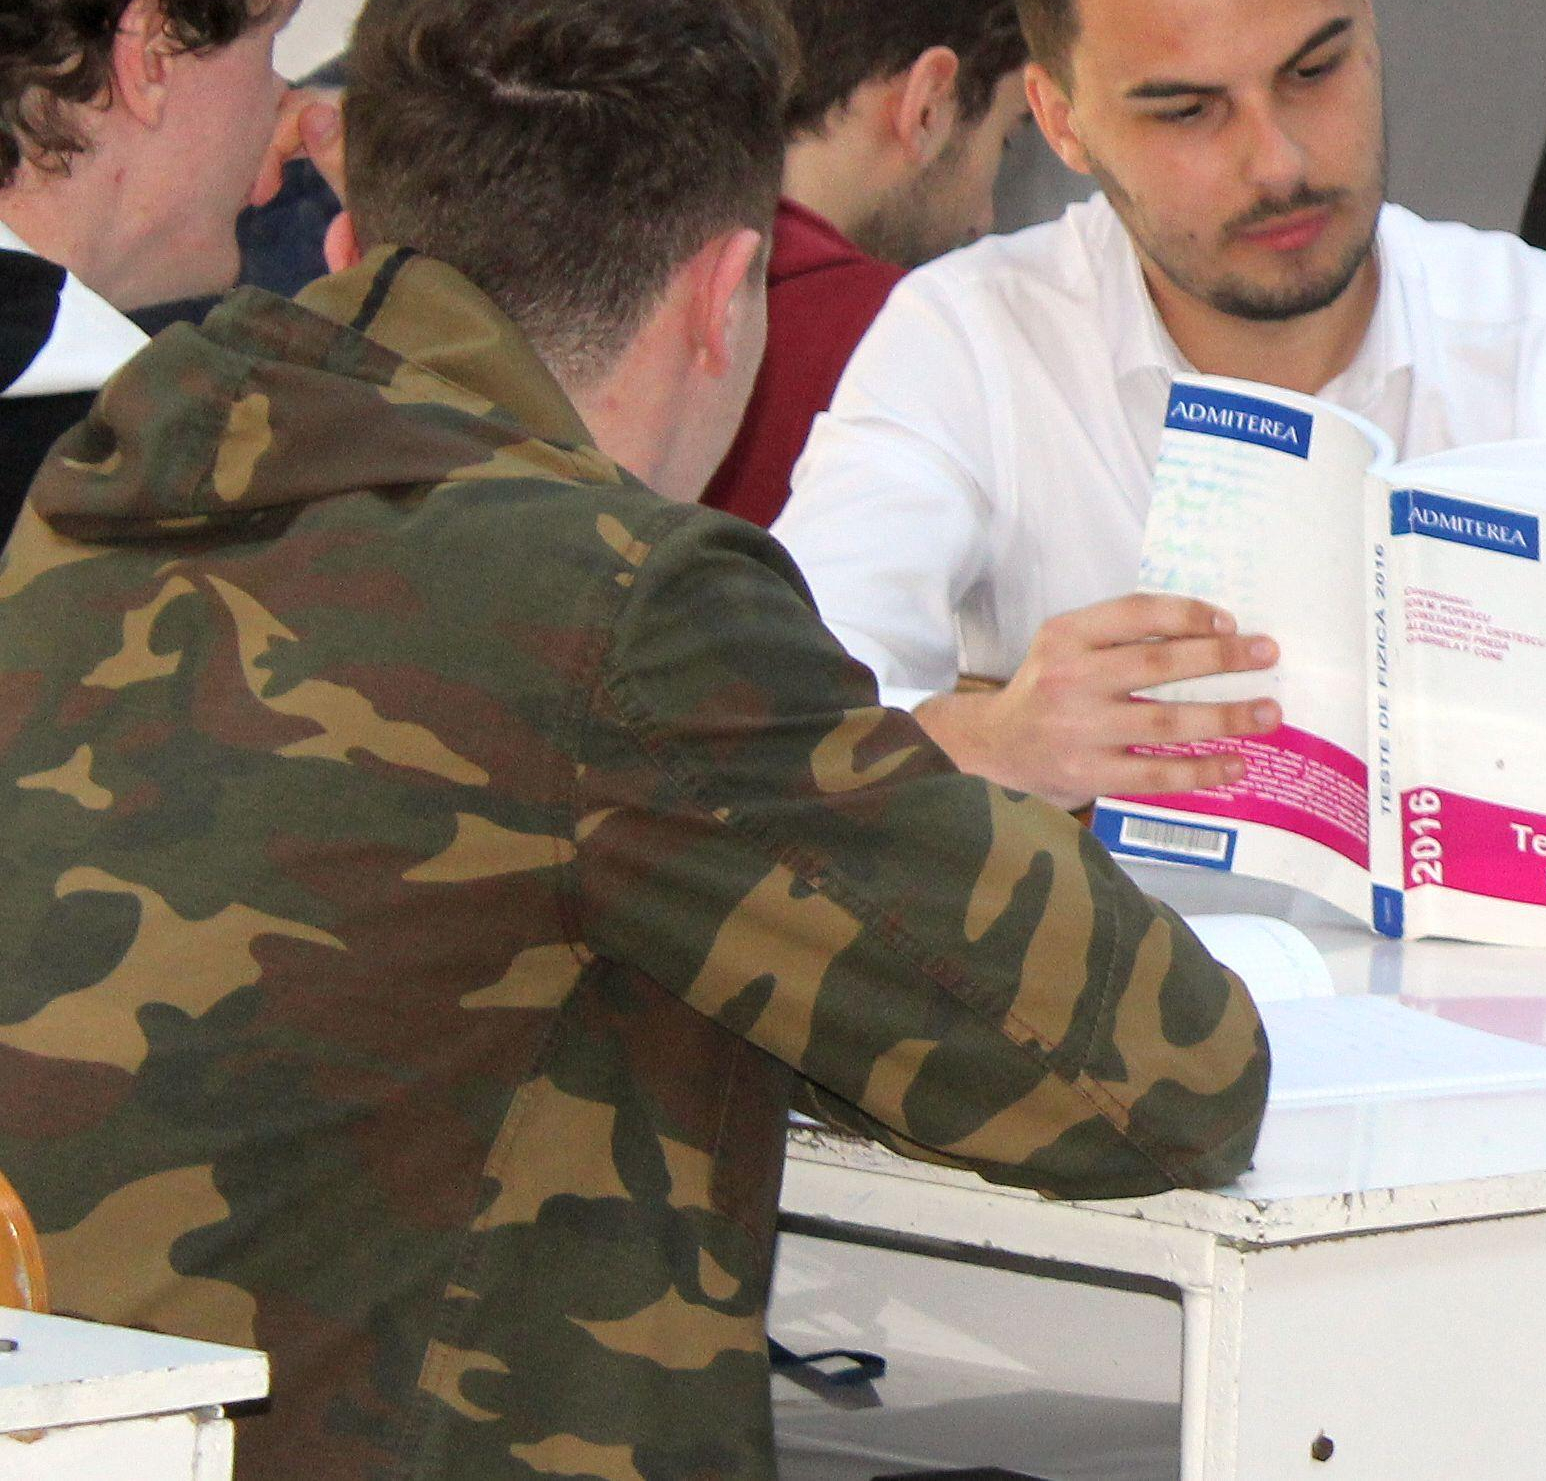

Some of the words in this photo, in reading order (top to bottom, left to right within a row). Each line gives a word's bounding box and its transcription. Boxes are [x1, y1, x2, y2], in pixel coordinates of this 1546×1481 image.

[1171, 400, 1299, 446] ADMITEREA
[1408, 506, 1527, 548] ADMITEREA
[1375, 543, 1386, 600] 2016
[1405, 610, 1472, 630] CONSTANTIN
[1440, 603, 1492, 622] POPESCU
[1377, 696, 1391, 730] DE
[1379, 739, 1393, 816] TESTE
[1408, 790, 1443, 885] 2016
